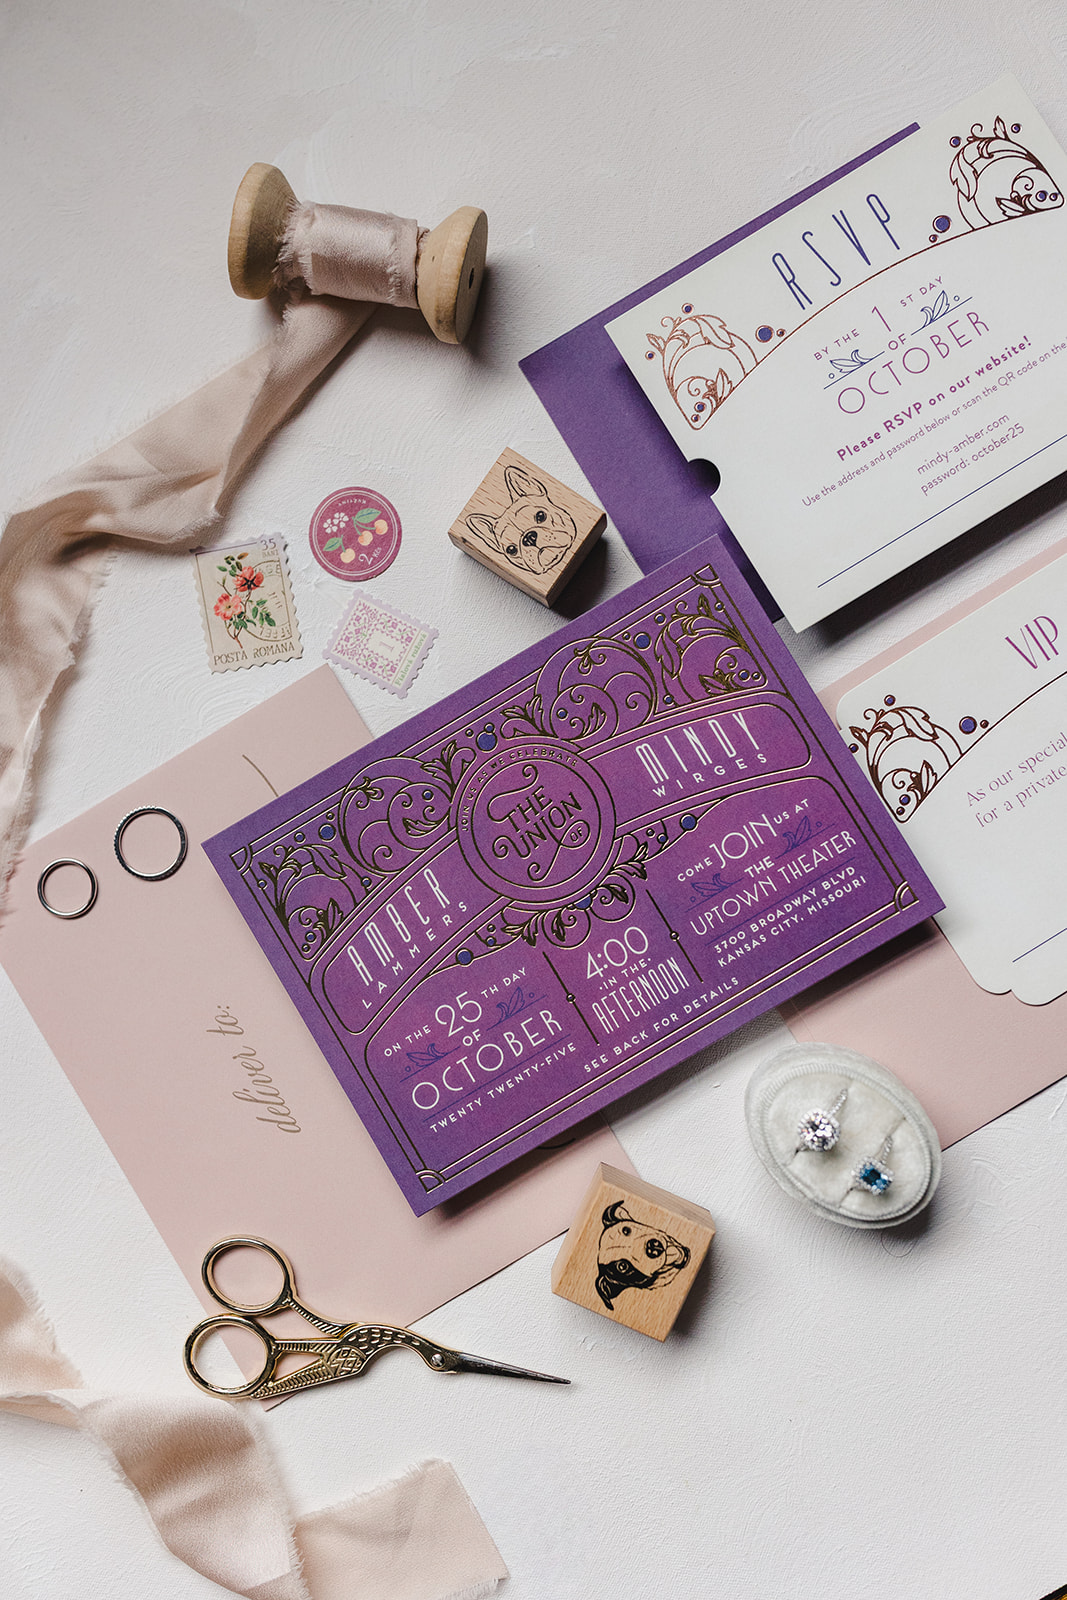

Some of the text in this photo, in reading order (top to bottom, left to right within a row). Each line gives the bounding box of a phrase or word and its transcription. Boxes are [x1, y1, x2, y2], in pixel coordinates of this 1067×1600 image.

[772, 194, 900, 310] RSVP
[814, 276, 944, 360] BY THE 1 ST DAY
[888, 334, 907, 350] OF
[836, 335, 1032, 462] Please RSVP on our website!
[838, 312, 989, 414] OCTOBER
[802, 342, 1066, 507] Use the address and password below or scan the QR code on the
[917, 413, 1010, 475] mindy-amber.com
[920, 422, 1025, 496] password: october25
[260, 538, 276, 551] 35
[358, 553, 373, 565] 2
[214, 642, 295, 666] POSTA ROMANA
[1004, 616, 1059, 670] VIP
[636, 712, 759, 785] MINDY
[652, 752, 767, 798] WIRGES
[461, 748, 578, 832] JOIN US AS WE CELEBRATE
[487, 780, 553, 833] THE
[492, 792, 582, 860] UNION
[966, 787, 986, 807] As
[988, 769, 1014, 791] our
[975, 766, 1067, 828] for a private
[570, 826, 583, 843] OF
[677, 799, 809, 882] COME JOIN US AT
[744, 856, 775, 878] THE
[690, 830, 857, 935] UPTOWN THEATER
[714, 866, 856, 954] 3700 BROADWAY BLVD
[348, 868, 450, 986] AMBER
[362, 901, 467, 1009] LAMMERS
[587, 926, 648, 980] 4:00
[718, 875, 867, 968] KANSAS CITY, MISSOURI
[384, 968, 527, 1056] ON THE 25 TH DAY
[584, 977, 739, 1073] SEE BACK FOR DETAILS
[592, 957, 690, 1034] AFTERNOON
[206, 1005, 301, 1133] deliver to:
[412, 1010, 562, 1110] OCTOBER
[462, 1029, 482, 1046] OF
[430, 1042, 576, 1133] TWENTY TWENTY-FIVE
